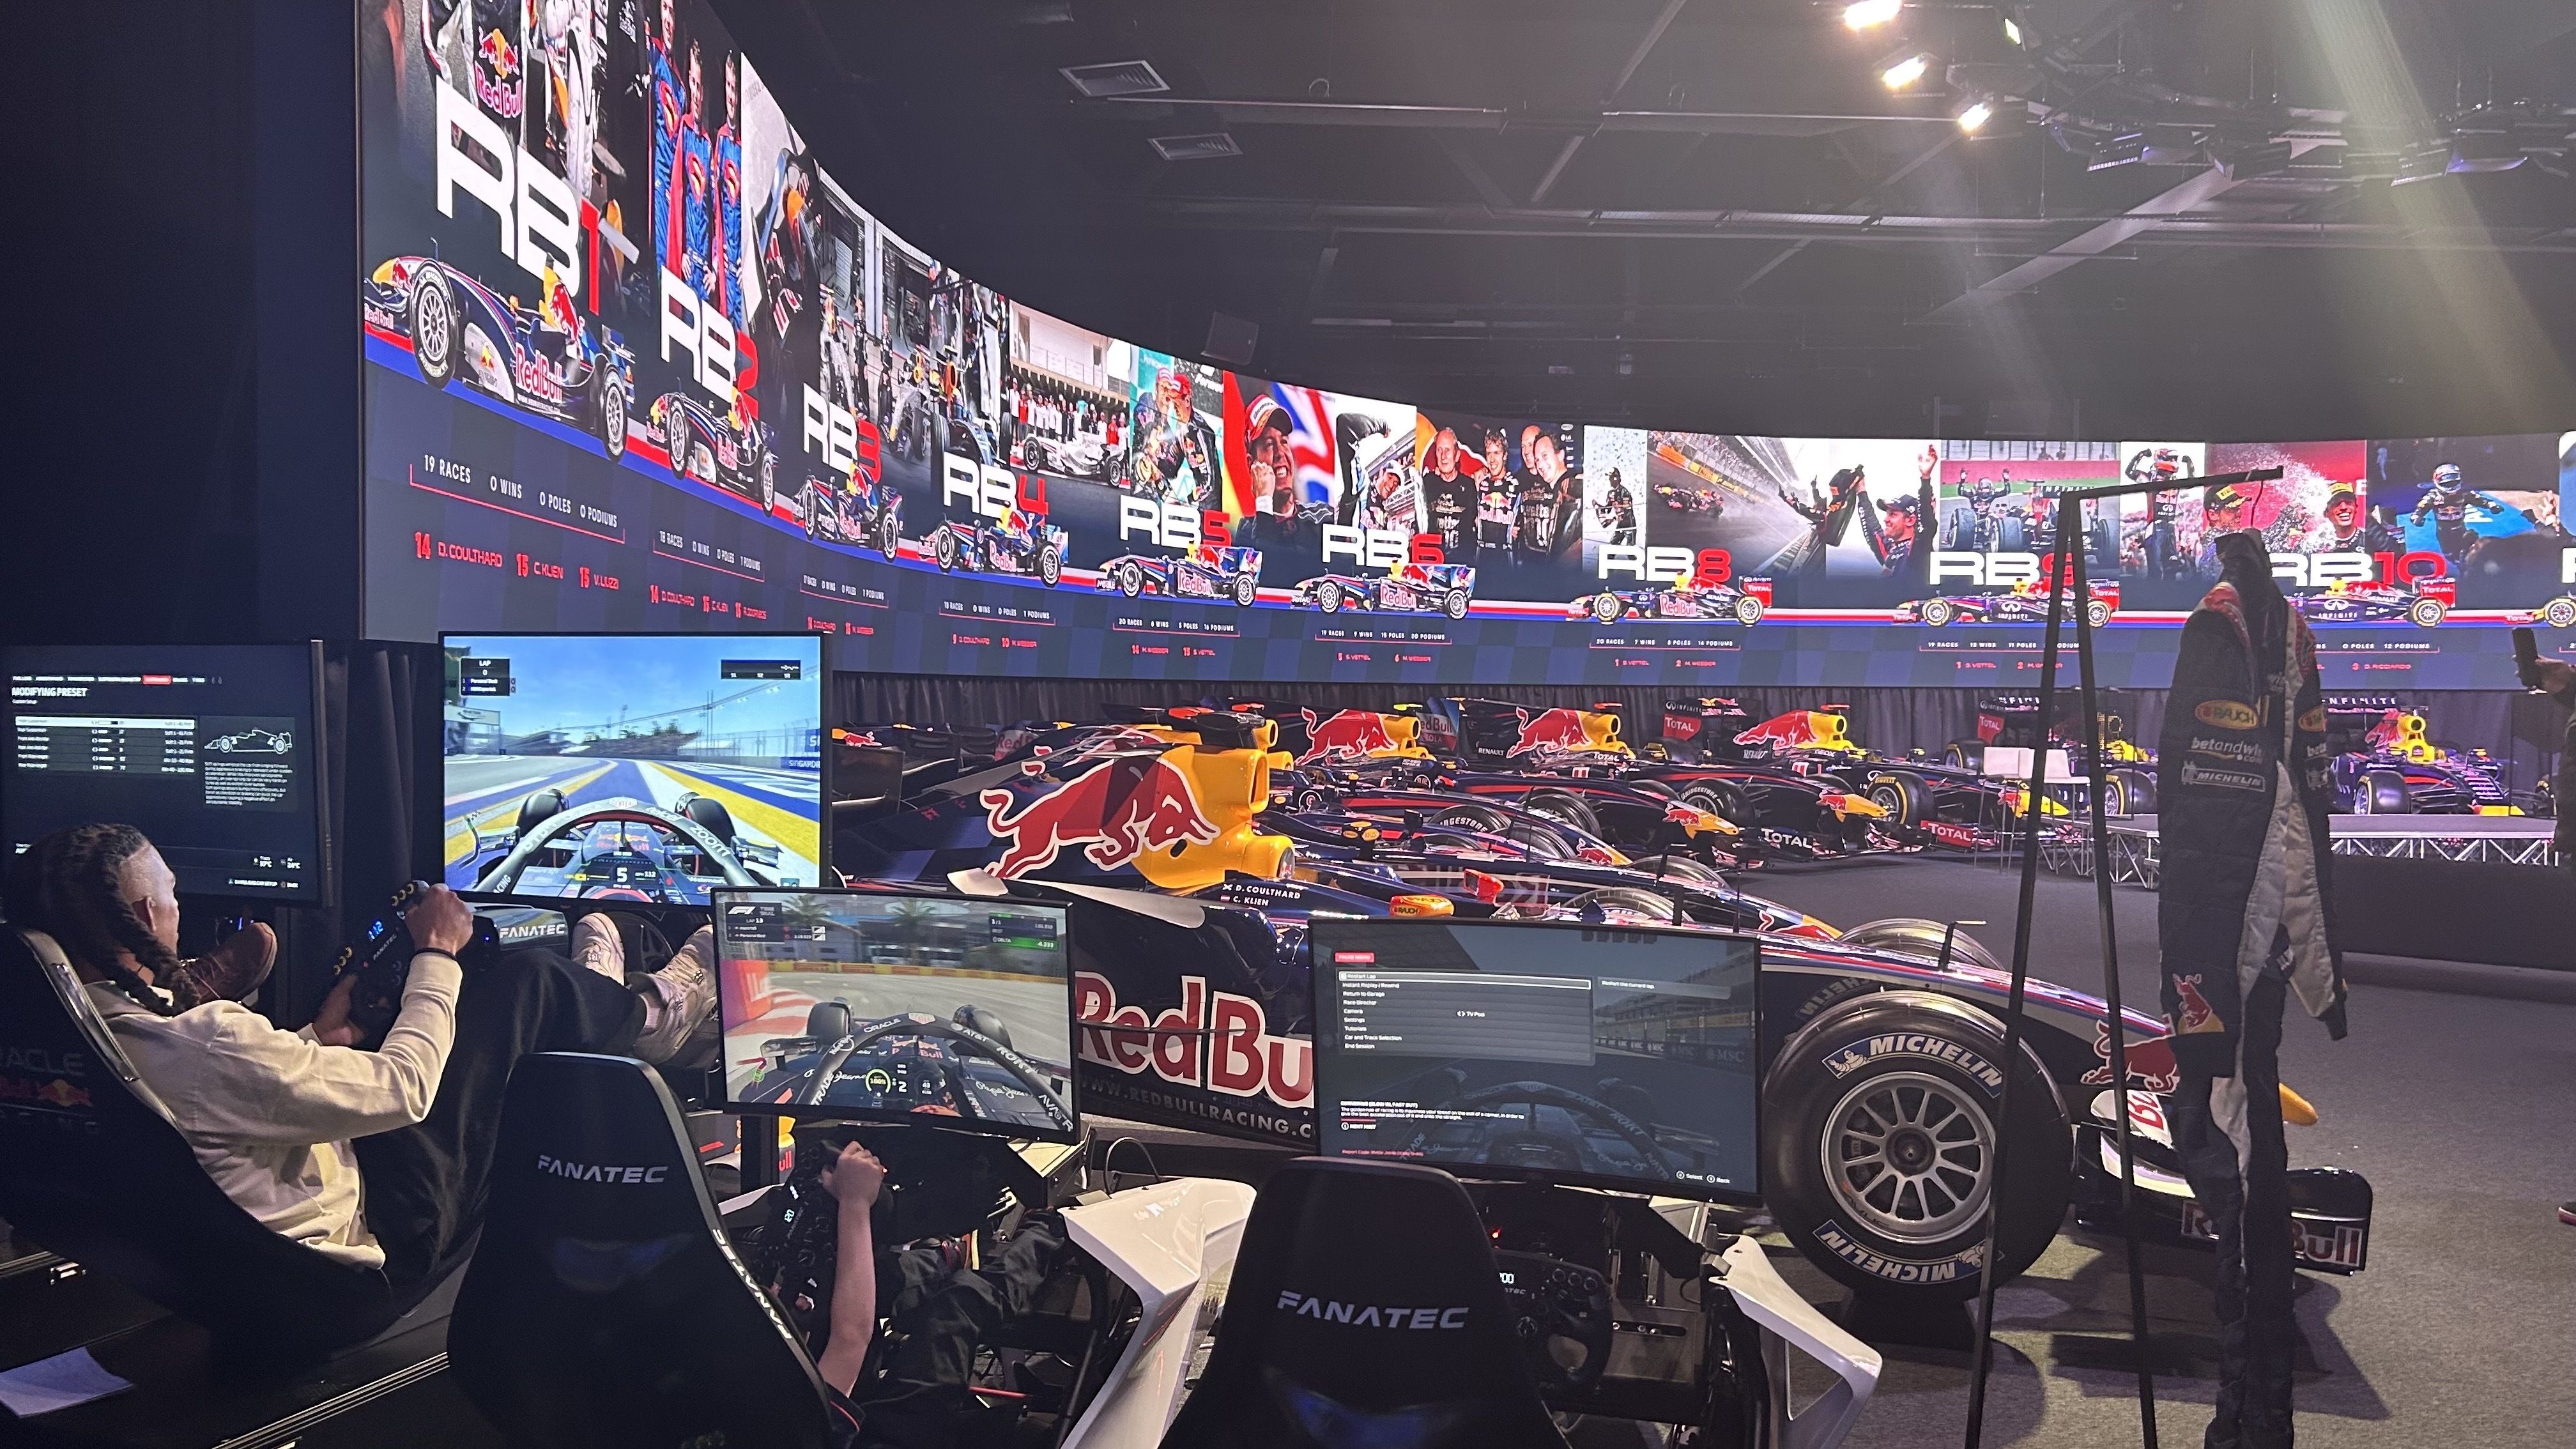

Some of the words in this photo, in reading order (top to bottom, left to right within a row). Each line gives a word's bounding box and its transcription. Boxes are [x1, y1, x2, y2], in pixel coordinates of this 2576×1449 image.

[475, 61, 501, 115] Red
[502, 78, 523, 118] Bull
[435, 73, 600, 316] RB1
[661, 265, 759, 420] RB2
[803, 382, 882, 484] RB3
[424, 454, 435, 473] 19
[439, 460, 471, 485] RACES
[490, 475, 497, 491] 0
[499, 478, 523, 500] WINS
[540, 491, 546, 506] 0
[548, 494, 572, 514] POLES
[580, 504, 586, 519] 0
[587, 506, 618, 528] PODIUMS
[942, 452, 1049, 526] RB4
[1119, 494, 1232, 549] RB5
[666, 532, 683, 549] RACES
[698, 542, 710, 557] WINS
[721, 550, 735, 564] POLES
[744, 556, 762, 572] PODIUMS
[1322, 525, 1445, 567] RB6
[414, 532, 431, 559] 14
[516, 554, 529, 578] 15
[579, 567, 590, 589] 15
[1598, 544, 1731, 582] RB8
[1747, 584, 1772, 592] TOTAL
[977, 605, 990, 615] WINS
[1003, 608, 1016, 617] POLES
[1027, 611, 1050, 620] PODIUMS
[1127, 618, 1142, 627] RACES
[12, 687, 56, 696] MODIFYING
[57, 687, 88, 697] PRESET
[1433, 717, 1453, 733] Bull
[1664, 717, 1694, 732] TOTAL
[1980, 716, 2000, 730] TOTAL
[1478, 747, 1505, 756] RENAULT
[1593, 751, 1620, 761] TOTAL
[1814, 749, 1836, 757] GEOX
[1607, 769, 1614, 780] 5
[2196, 770, 2262, 786] MICHELIN
[689, 824, 731, 857] zoom
[1761, 829, 1813, 849] TOTAL
[1928, 822, 1972, 842] TOTAL
[617, 866, 627, 882] 5
[644, 870, 656, 878] 112
[1244, 896, 1269, 907] KLIEN
[499, 924, 566, 939] FANATEC
[863, 1018, 901, 1033] ORACLE
[962, 1029, 990, 1043] AT&T
[1207, 990, 1315, 1109] Bu
[1869, 1033, 2005, 1087] MICHELIN
[898, 1081, 907, 1092] 2
[537, 1154, 668, 1184] FANATEC
[1820, 1229, 1957, 1282] MICHELIN
[712, 1227, 793, 1341] FANATEC
[1277, 1290, 1469, 1330] FANATEC
